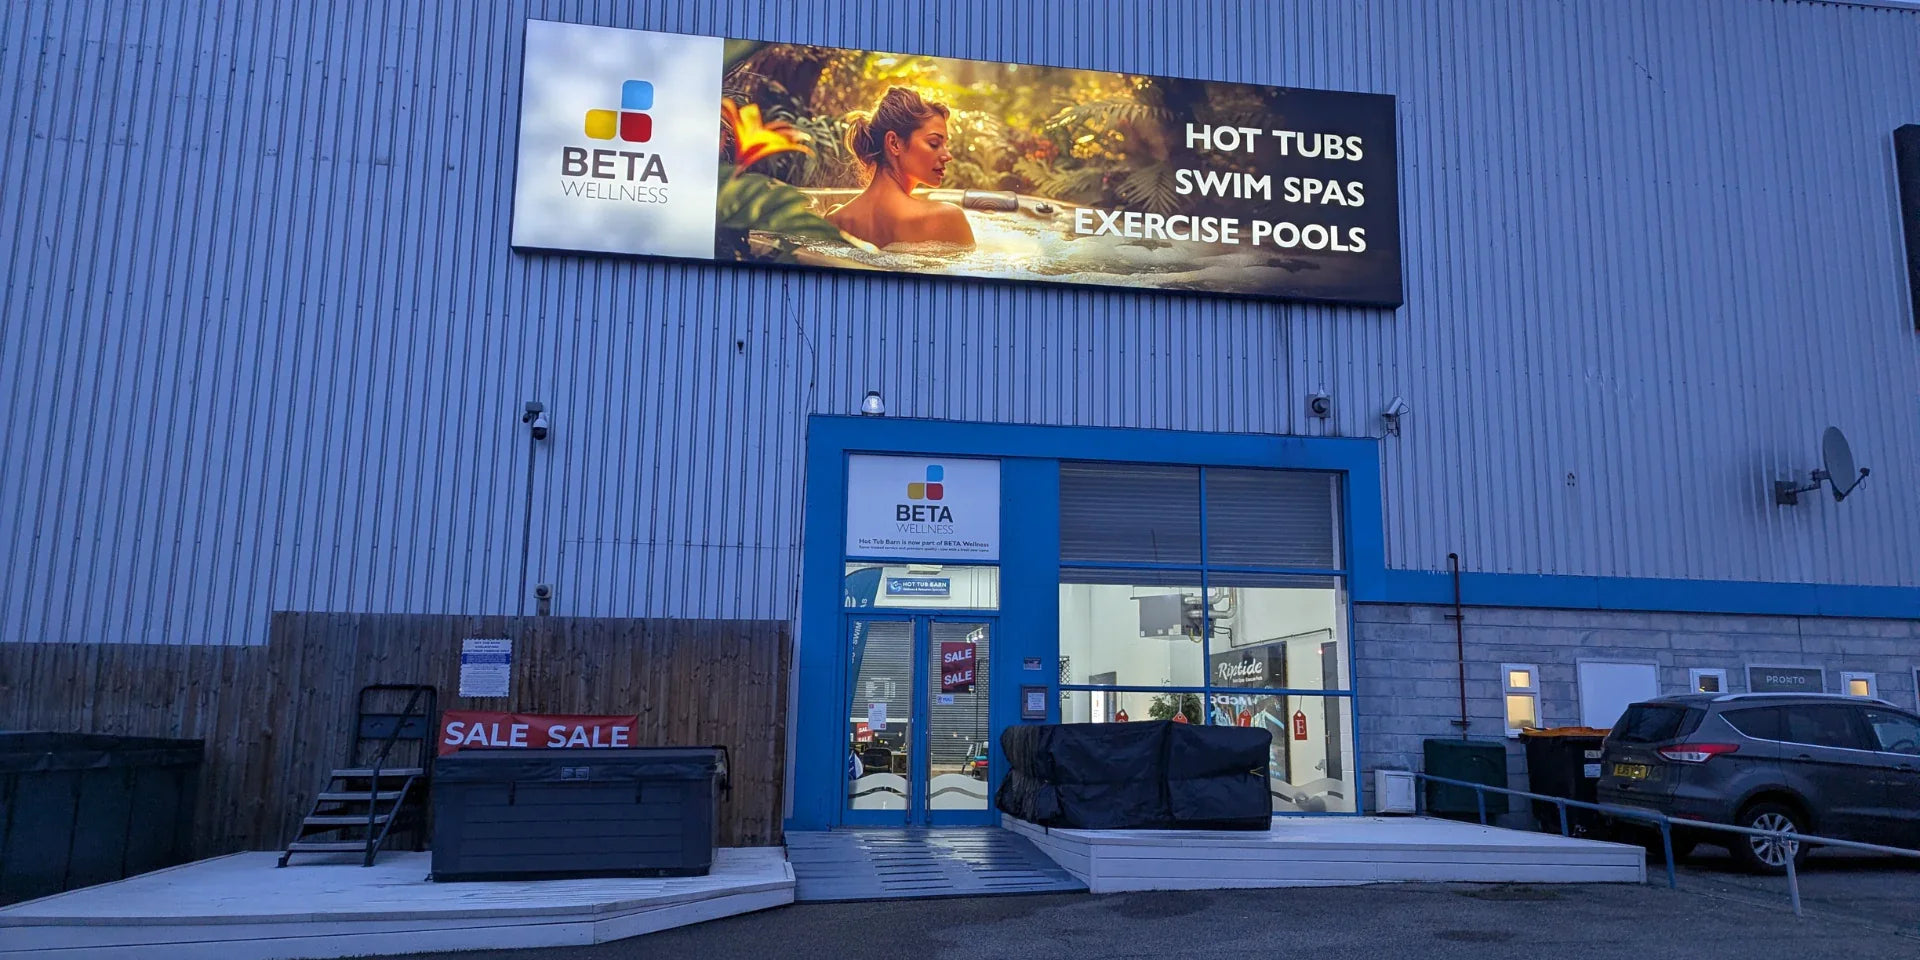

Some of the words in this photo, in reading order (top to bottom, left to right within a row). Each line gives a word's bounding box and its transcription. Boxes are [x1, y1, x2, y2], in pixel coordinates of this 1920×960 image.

[1186, 123, 1262, 153] HOT
[1272, 130, 1363, 161] TUBS
[561, 146, 669, 184] BETA
[561, 180, 669, 204] WELLNESS
[1175, 168, 1272, 200] SWIM
[1283, 177, 1365, 207] SPAS
[1074, 207, 1239, 245] EXERCISE
[1252, 220, 1367, 253] POOLS
[896, 504, 953, 523] BETA
[896, 523, 954, 535] WELLNESS
[944, 648, 972, 663] SALE
[944, 670, 972, 685] SALE
[1218, 658, 1263, 681] Riptide
[1766, 676, 1805, 684] PRONTO
[444, 721, 529, 747] SALE
[547, 725, 629, 748] SALE
